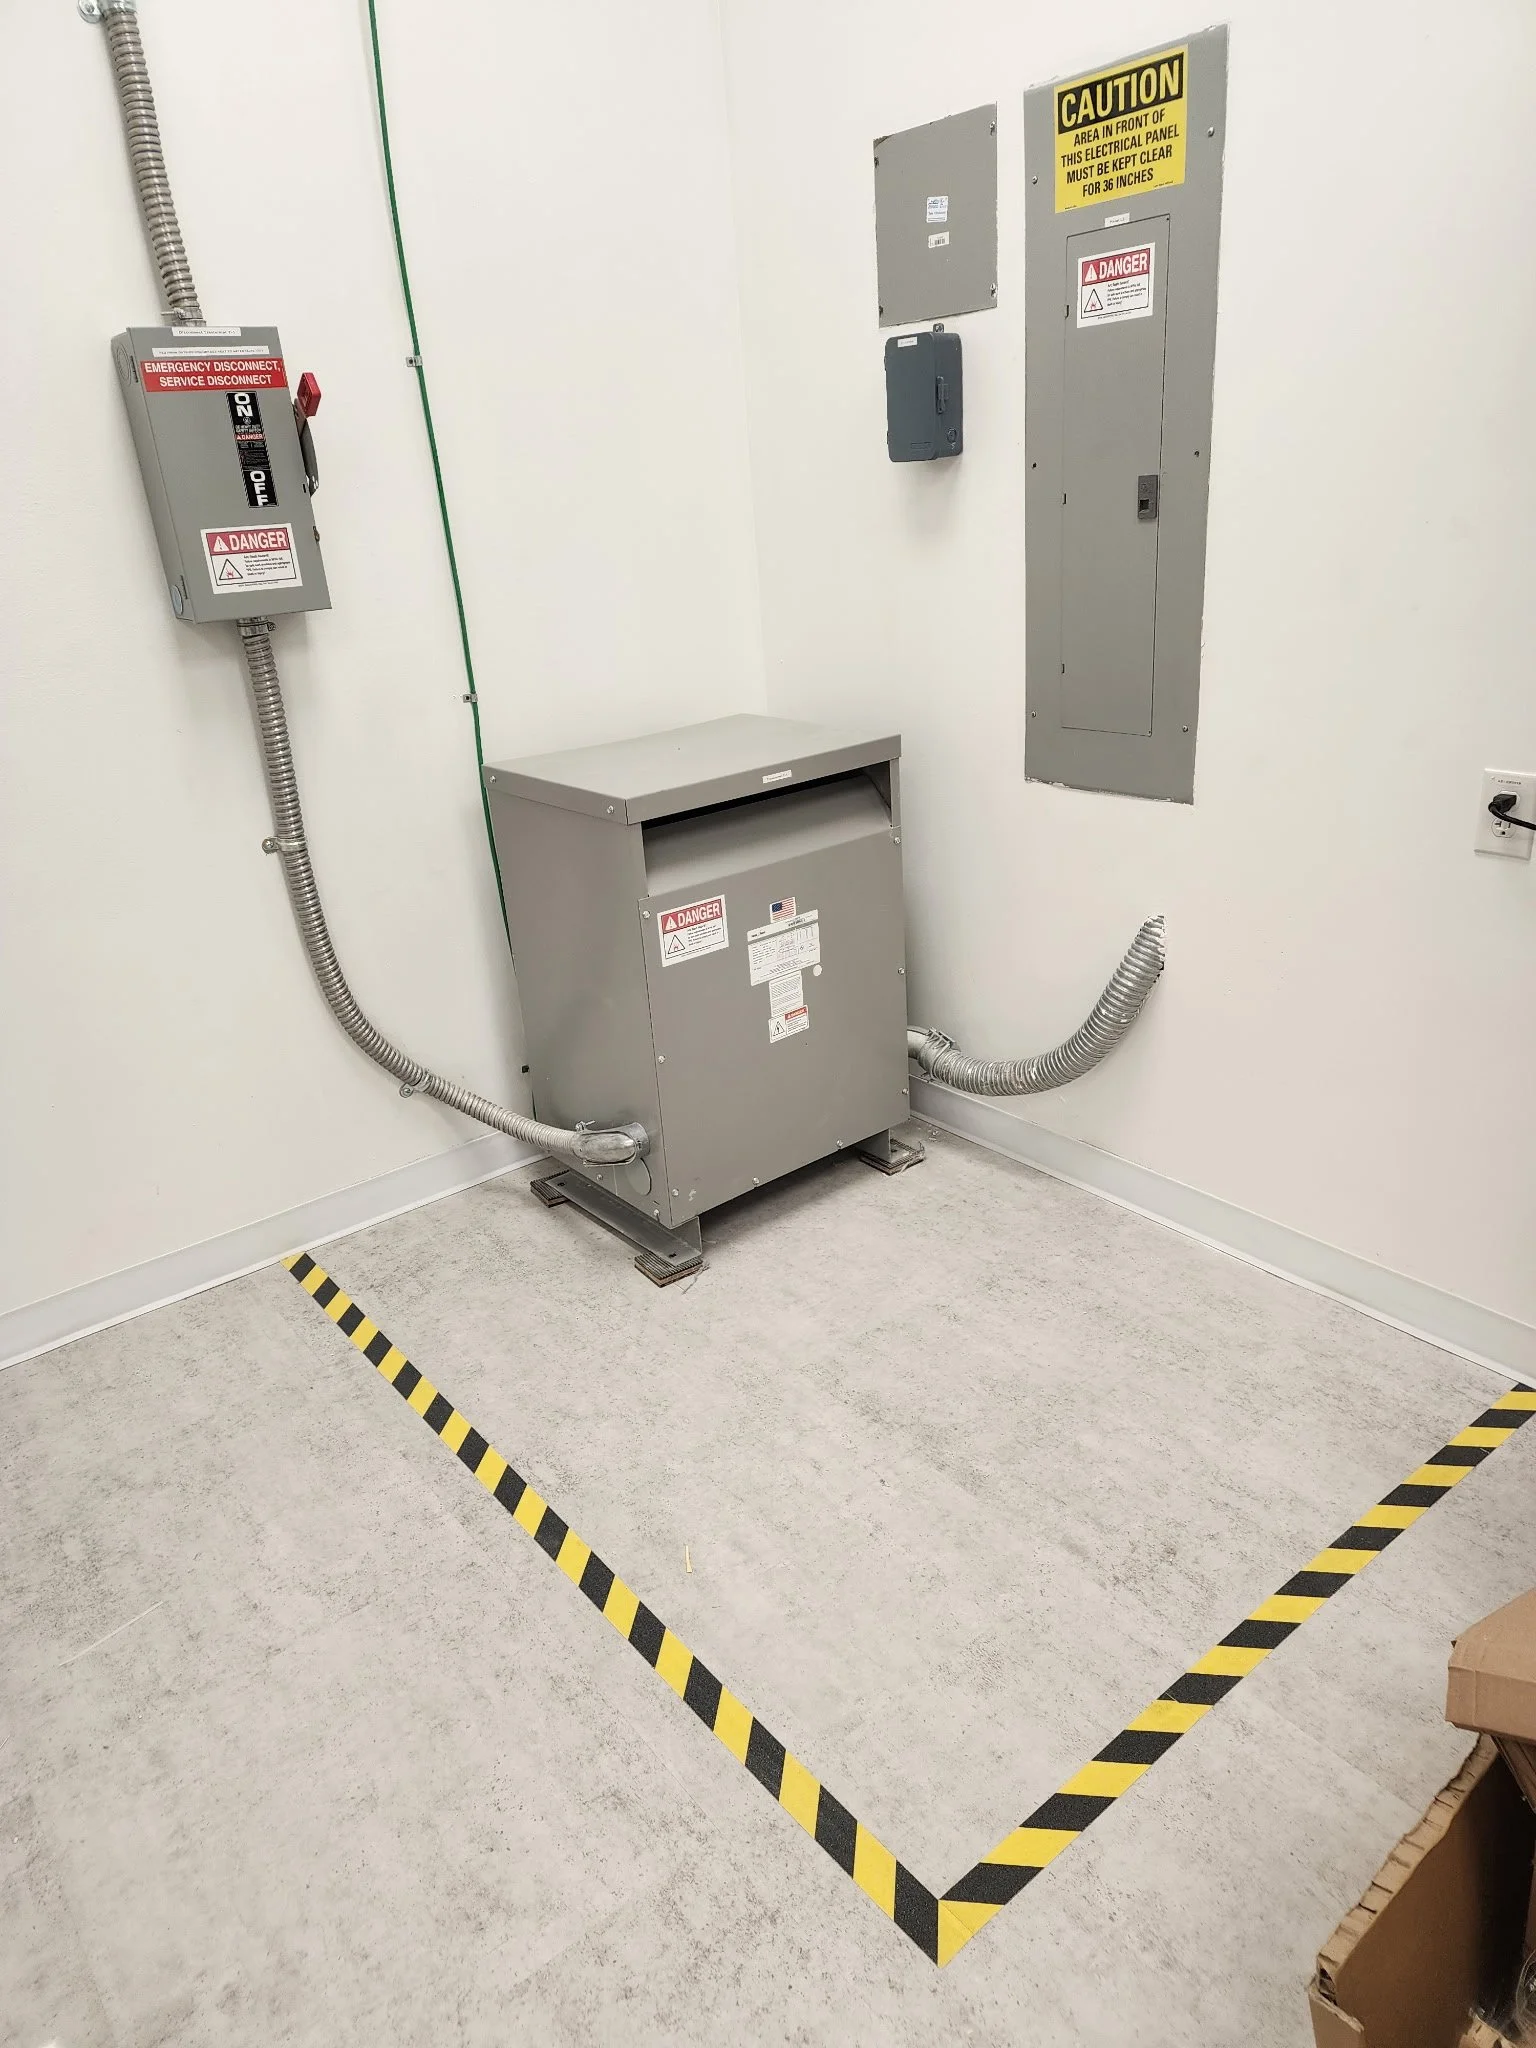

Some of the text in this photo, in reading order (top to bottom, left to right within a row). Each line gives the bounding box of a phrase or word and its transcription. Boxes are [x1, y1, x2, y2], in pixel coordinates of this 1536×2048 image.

[1061, 58, 1180, 128] CAUTION
[1074, 108, 1166, 147] AREA IN FRONT OF
[1061, 123, 1180, 168] THIS ELECTRICAL PANEL
[1066, 144, 1173, 184] MUST BE KEPT CLEAR
[1082, 181, 1101, 197] FOR
[1103, 178, 1114, 193] 36
[1116, 167, 1154, 189] INCHES
[1099, 252, 1149, 280] DANGER
[144, 360, 281, 374] EMERGENCY DISCONNECT,
[159, 374, 272, 387] SERVICE DISCONNECT
[234, 392, 254, 417] ON
[249, 470, 269, 506] OFF
[228, 531, 287, 551] DANGER
[677, 902, 721, 927] DANGER
